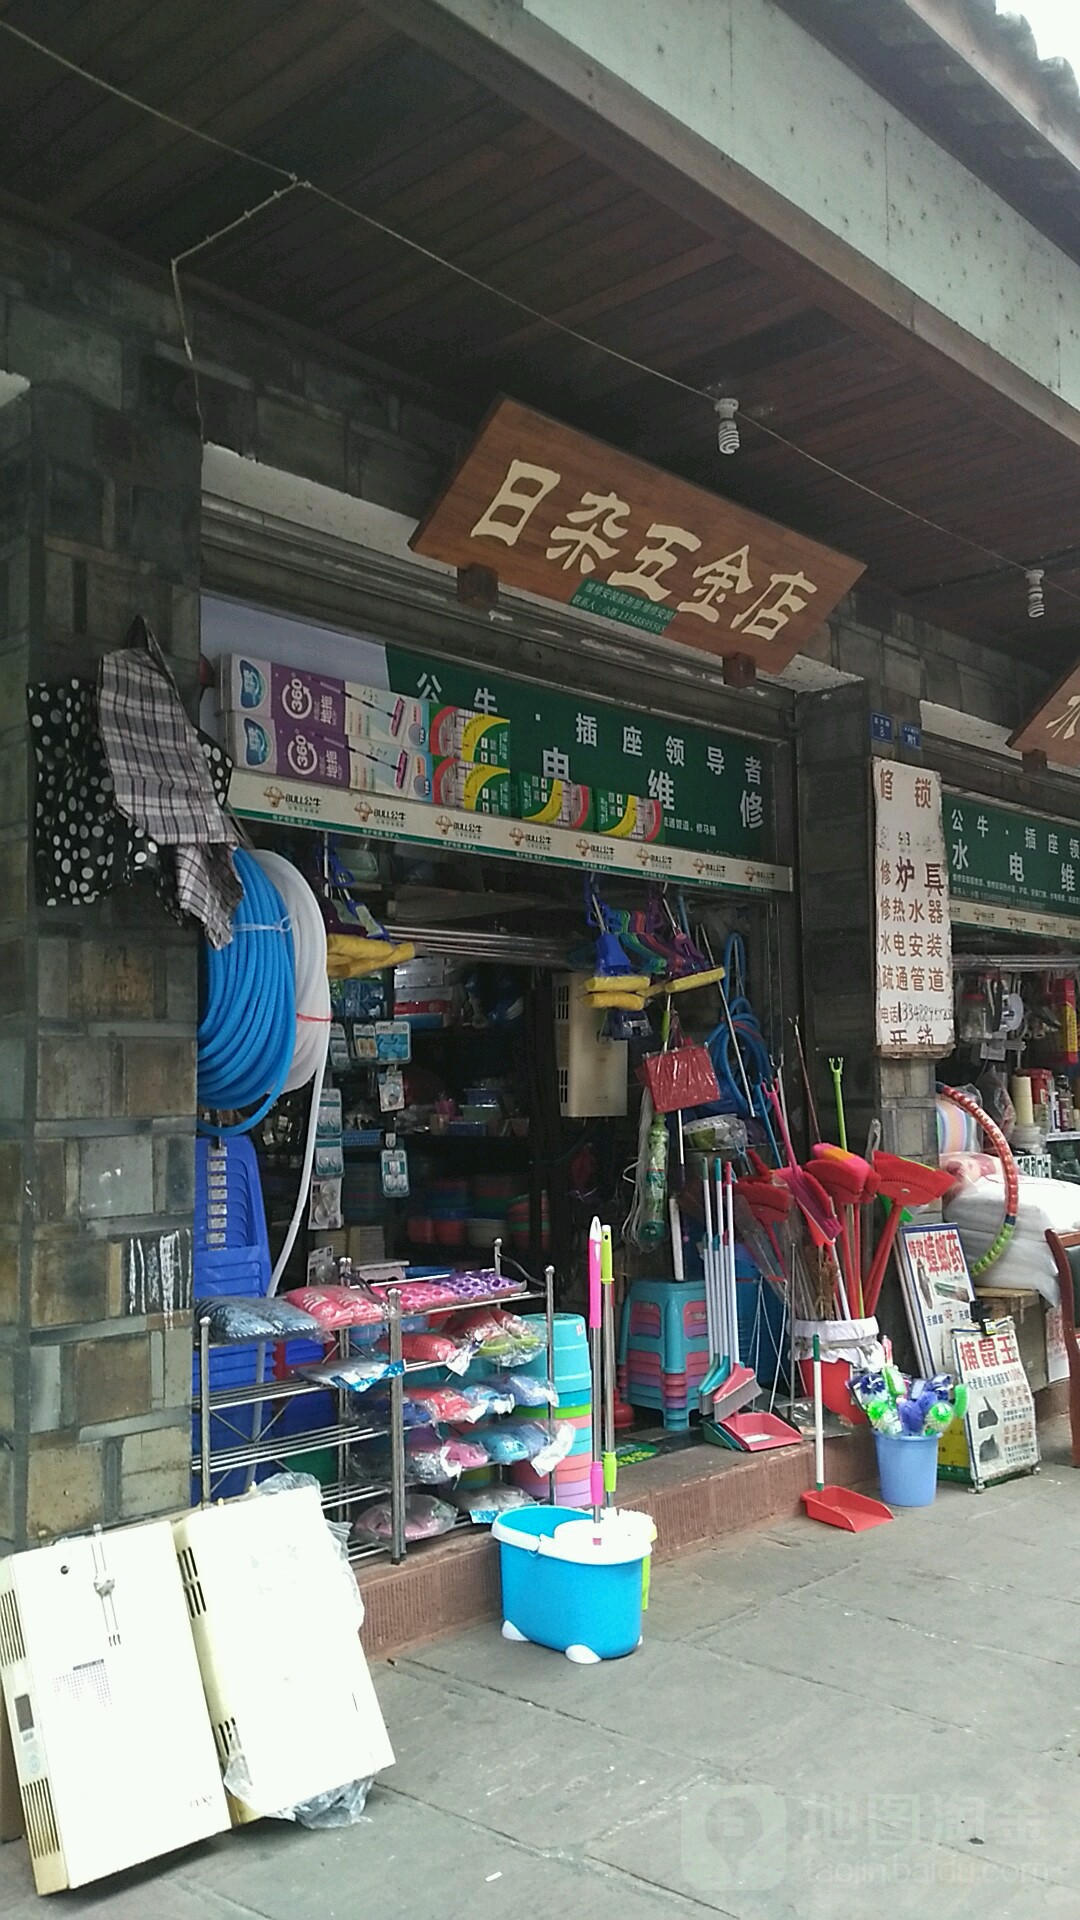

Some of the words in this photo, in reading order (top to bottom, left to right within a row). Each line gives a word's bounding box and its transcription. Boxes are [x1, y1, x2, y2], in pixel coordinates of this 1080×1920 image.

[471, 459, 818, 640] 日杂五金店
[880, 768, 932, 809] 修锁
[880, 856, 945, 897] 修炉具
[880, 893, 944, 925] 修热水器
[880, 930, 943, 958] 水电安装
[881, 965, 945, 992] 疏通管道
[960, 1334, 1018, 1371] 捕鼠王
